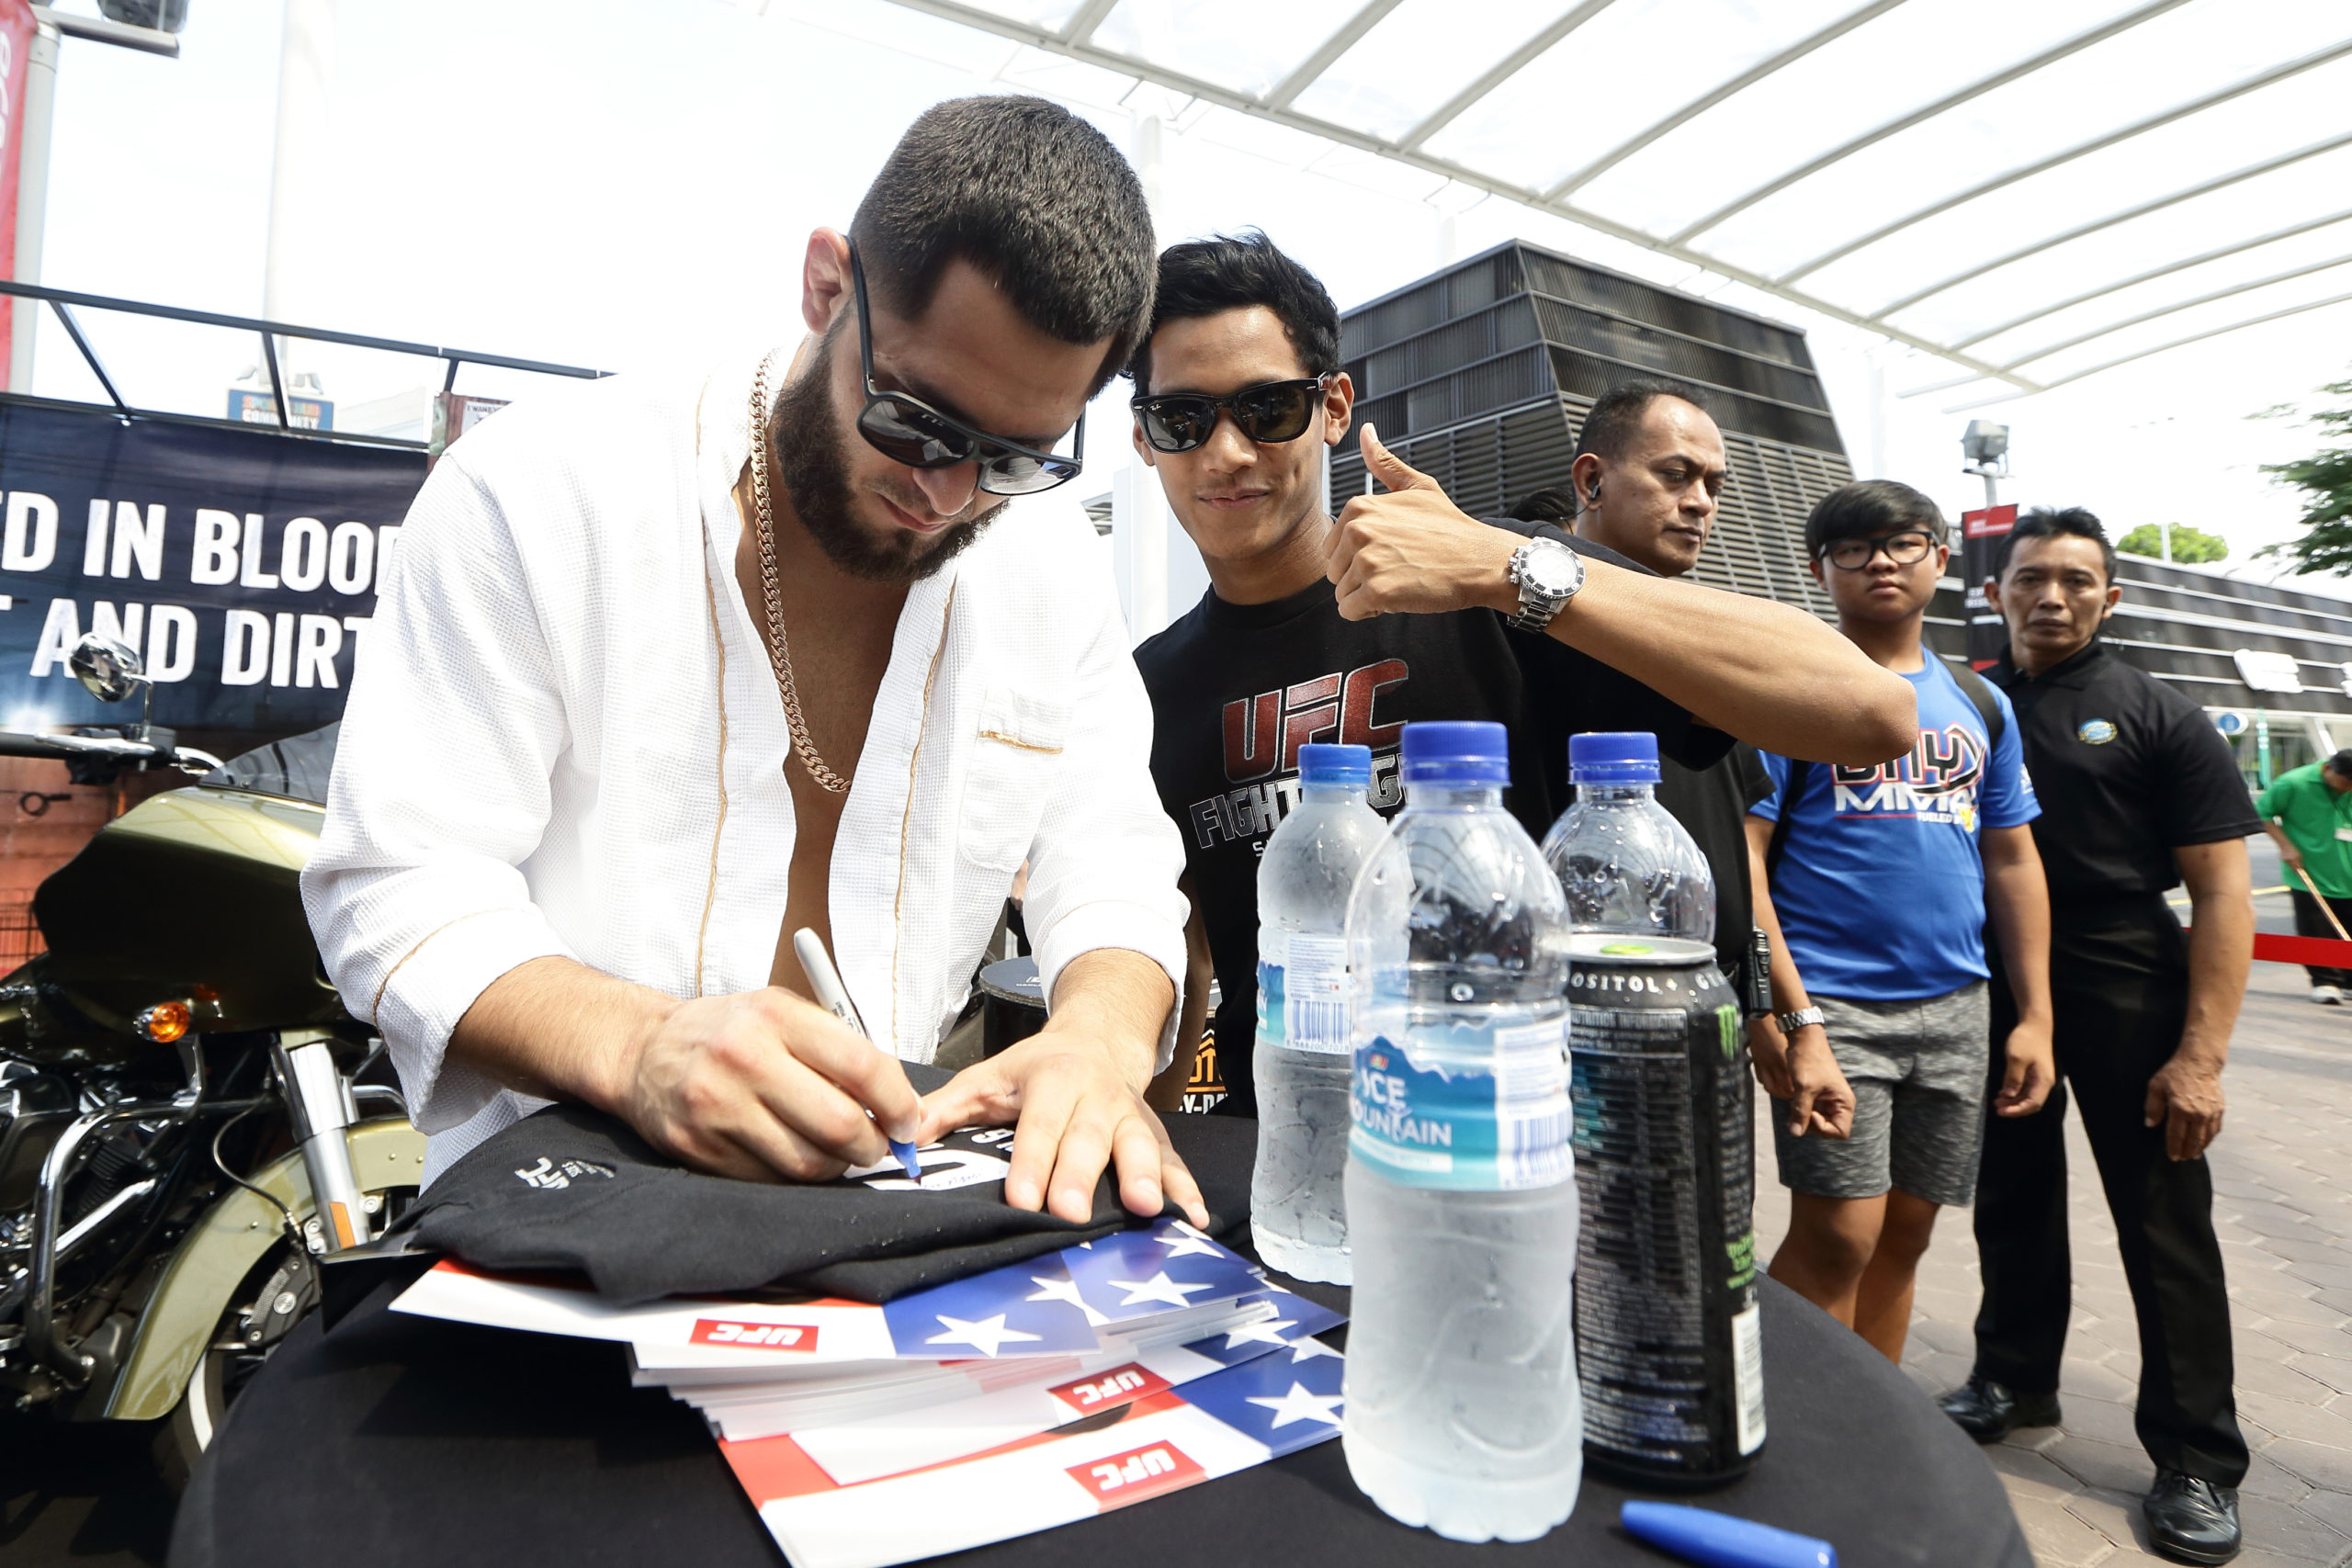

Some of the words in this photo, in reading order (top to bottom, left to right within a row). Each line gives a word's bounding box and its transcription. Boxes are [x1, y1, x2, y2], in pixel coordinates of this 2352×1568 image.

[83, 498, 166, 581] IN
[29, 597, 198, 682] AND
[1222, 658, 1409, 784] UFC
[1189, 776, 1303, 850] FIGHT
[1834, 782, 1976, 813] MMA
[1570, 972, 1662, 994] OSITOL
[1361, 1068, 1406, 1108] ICE
[1351, 1097, 1452, 1146] OUNTAIN
[707, 1323, 804, 1346] UFC
[1072, 1369, 1147, 1405] UFC
[1091, 1448, 1177, 1491] UFC
